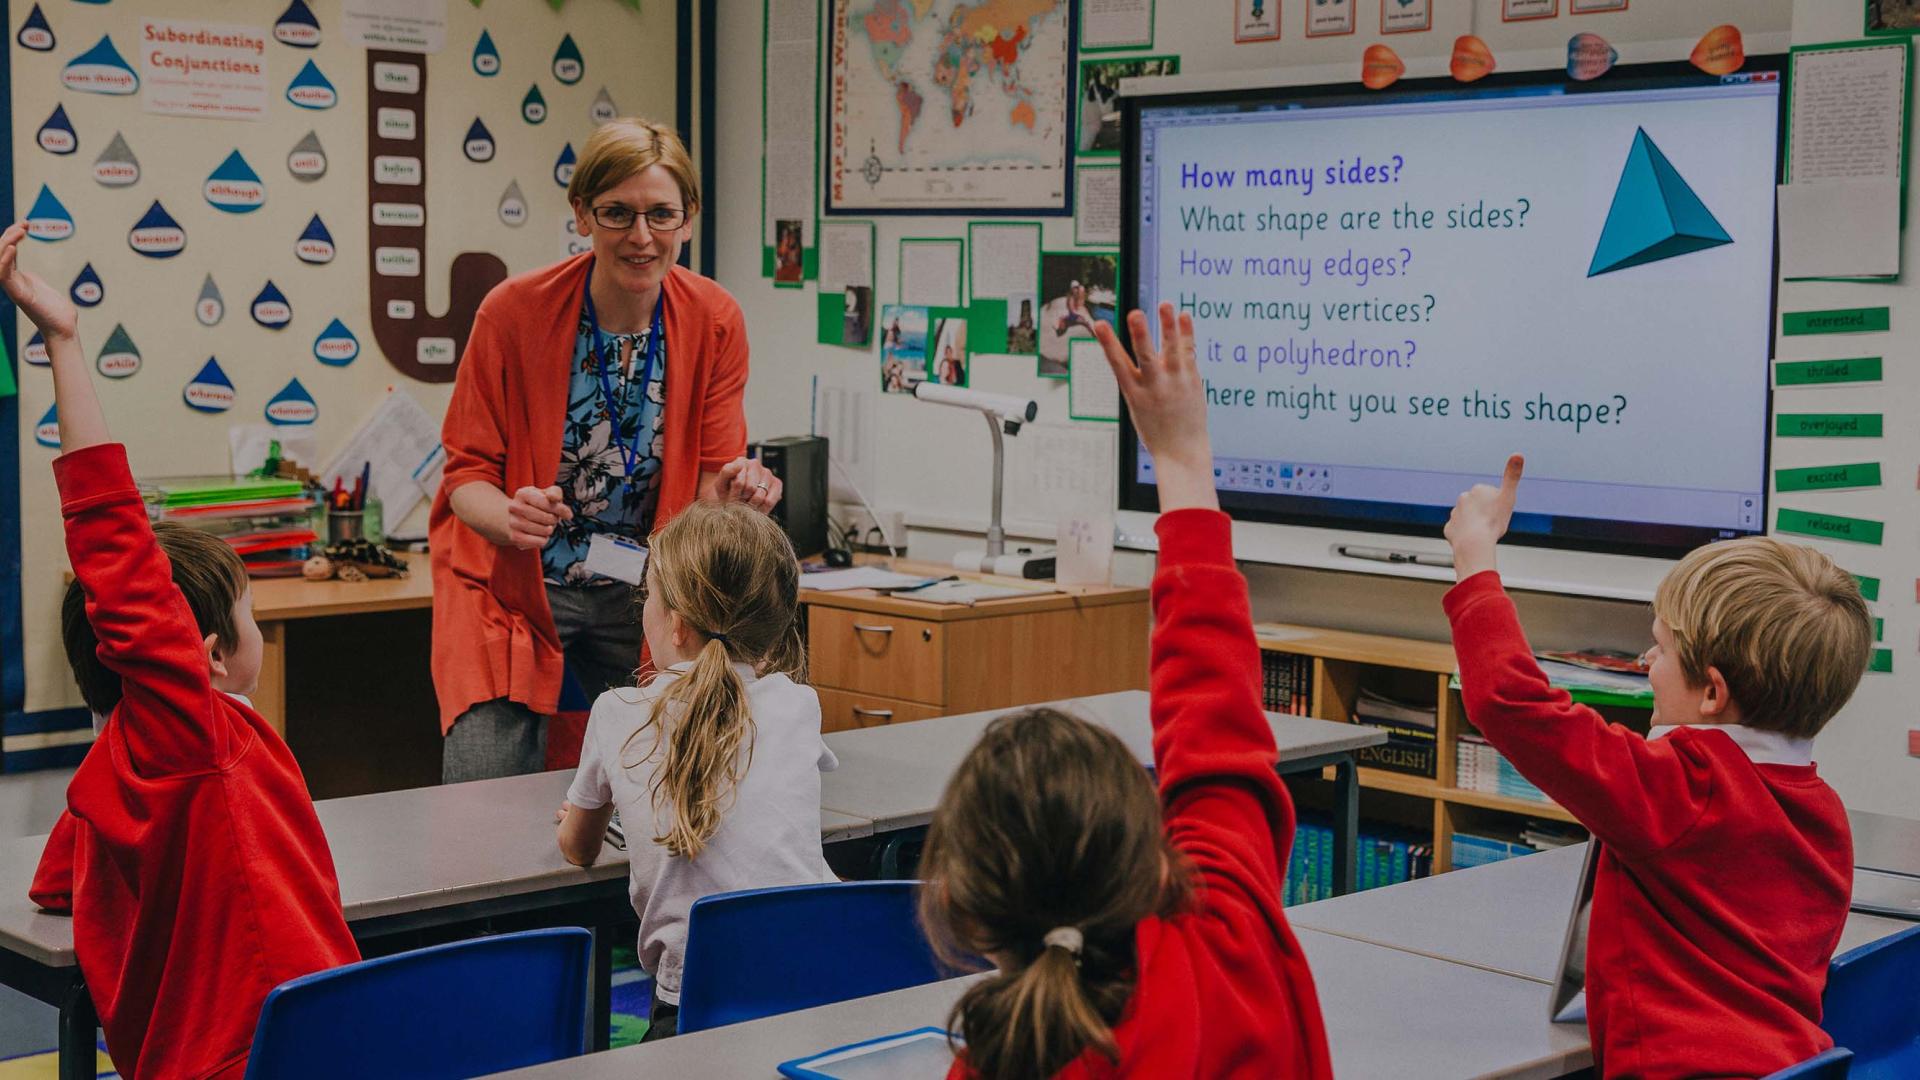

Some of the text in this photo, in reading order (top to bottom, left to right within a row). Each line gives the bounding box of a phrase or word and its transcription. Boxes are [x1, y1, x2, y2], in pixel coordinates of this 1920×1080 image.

[144, 24, 264, 56] Subordinating
[149, 50, 260, 76] Conjunctions
[834, 0, 846, 201] MAP OF THE WORL
[1181, 155, 1404, 195] How many sides?
[1180, 198, 1530, 241] What shape are the sides?
[1180, 248, 1412, 287] How many edges?
[1179, 292, 1436, 331] How many vertices?
[1806, 311, 1864, 329] interested
[1207, 338, 1223, 363] it
[1233, 345, 1248, 363] a
[1258, 338, 1417, 375] polyhedron?
[1201, 379, 1628, 433] here might you see this shape?
[1800, 418, 1858, 435] overjoyed
[1806, 469, 1848, 484] excited
[1807, 519, 1852, 534] relaxed
[1360, 746, 1425, 769] ENGLISH
